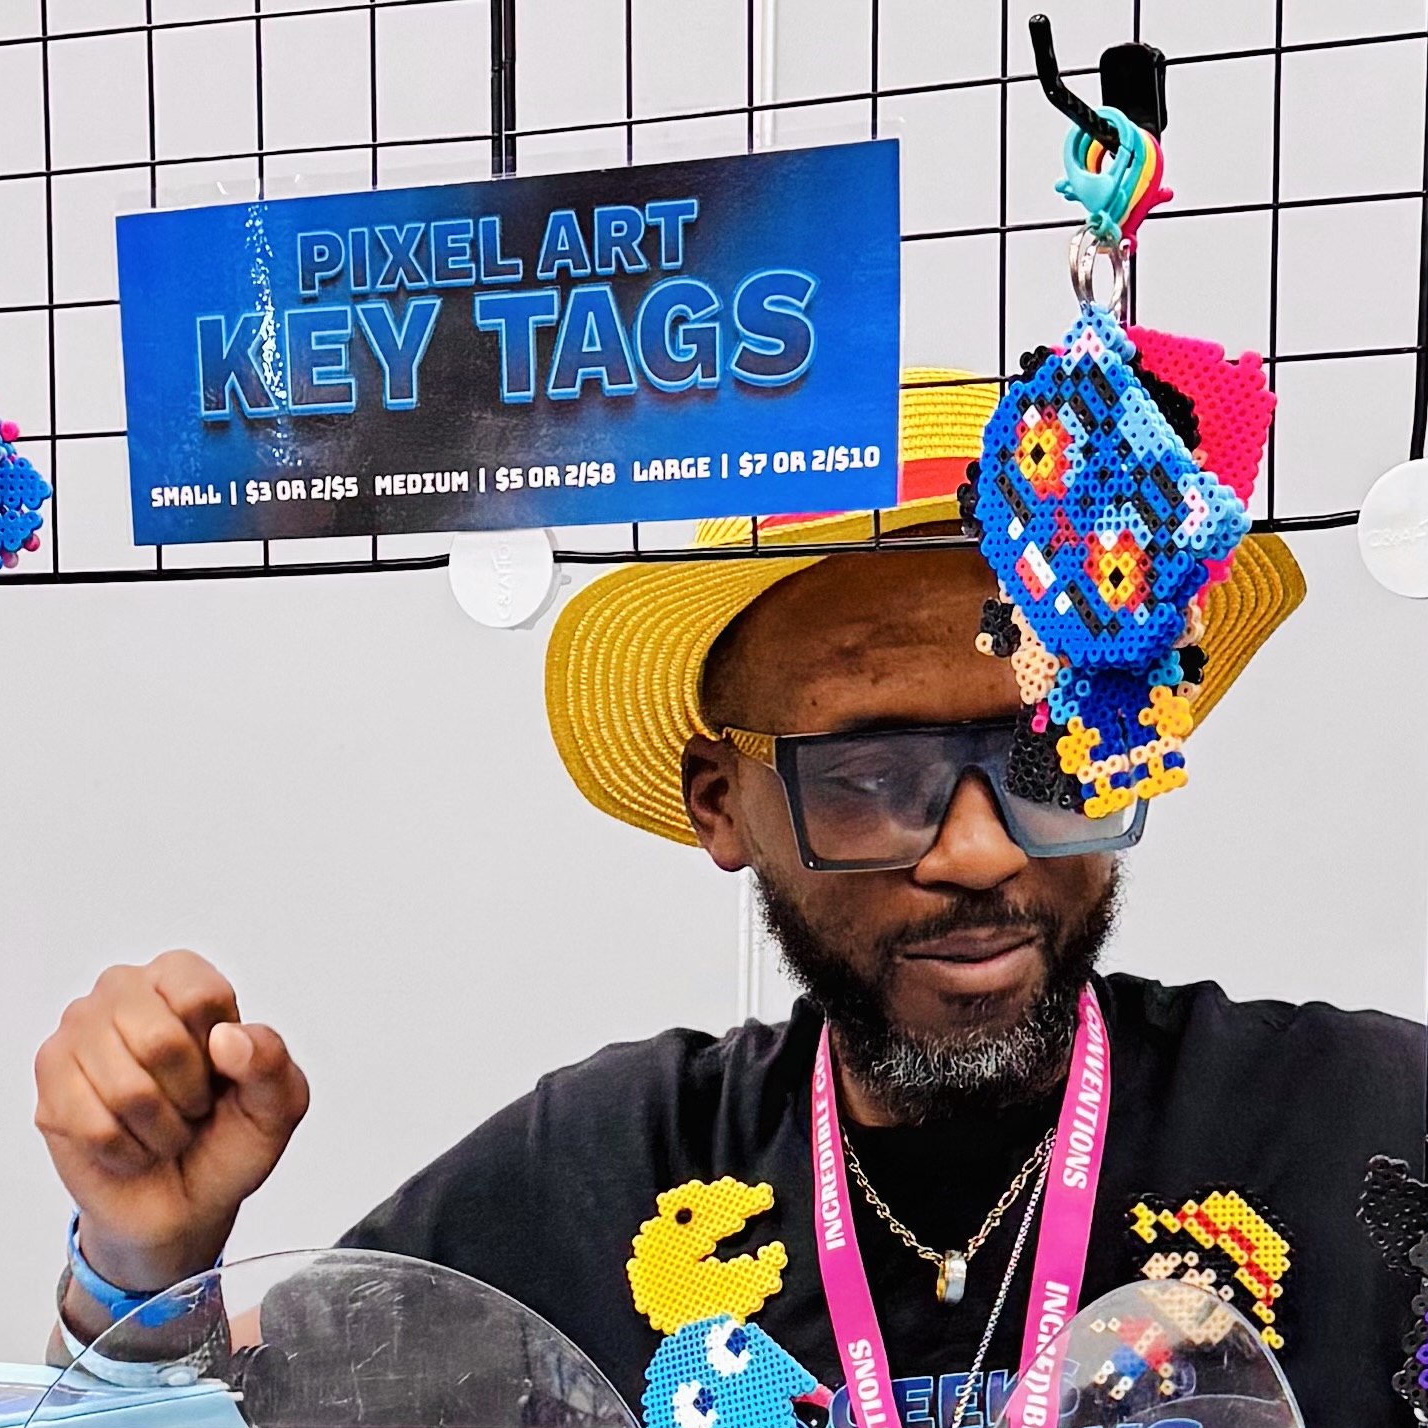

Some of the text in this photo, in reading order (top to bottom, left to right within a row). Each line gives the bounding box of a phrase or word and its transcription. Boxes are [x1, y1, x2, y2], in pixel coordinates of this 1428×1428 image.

[298, 199, 699, 298] PIXEL ART
[195, 269, 820, 422] KEY TAGS
[151, 446, 880, 508] SMALL $3 OR 2/$5 MEDIUM $5 OR 2/$8 LARGE $7 OR 2/$10
